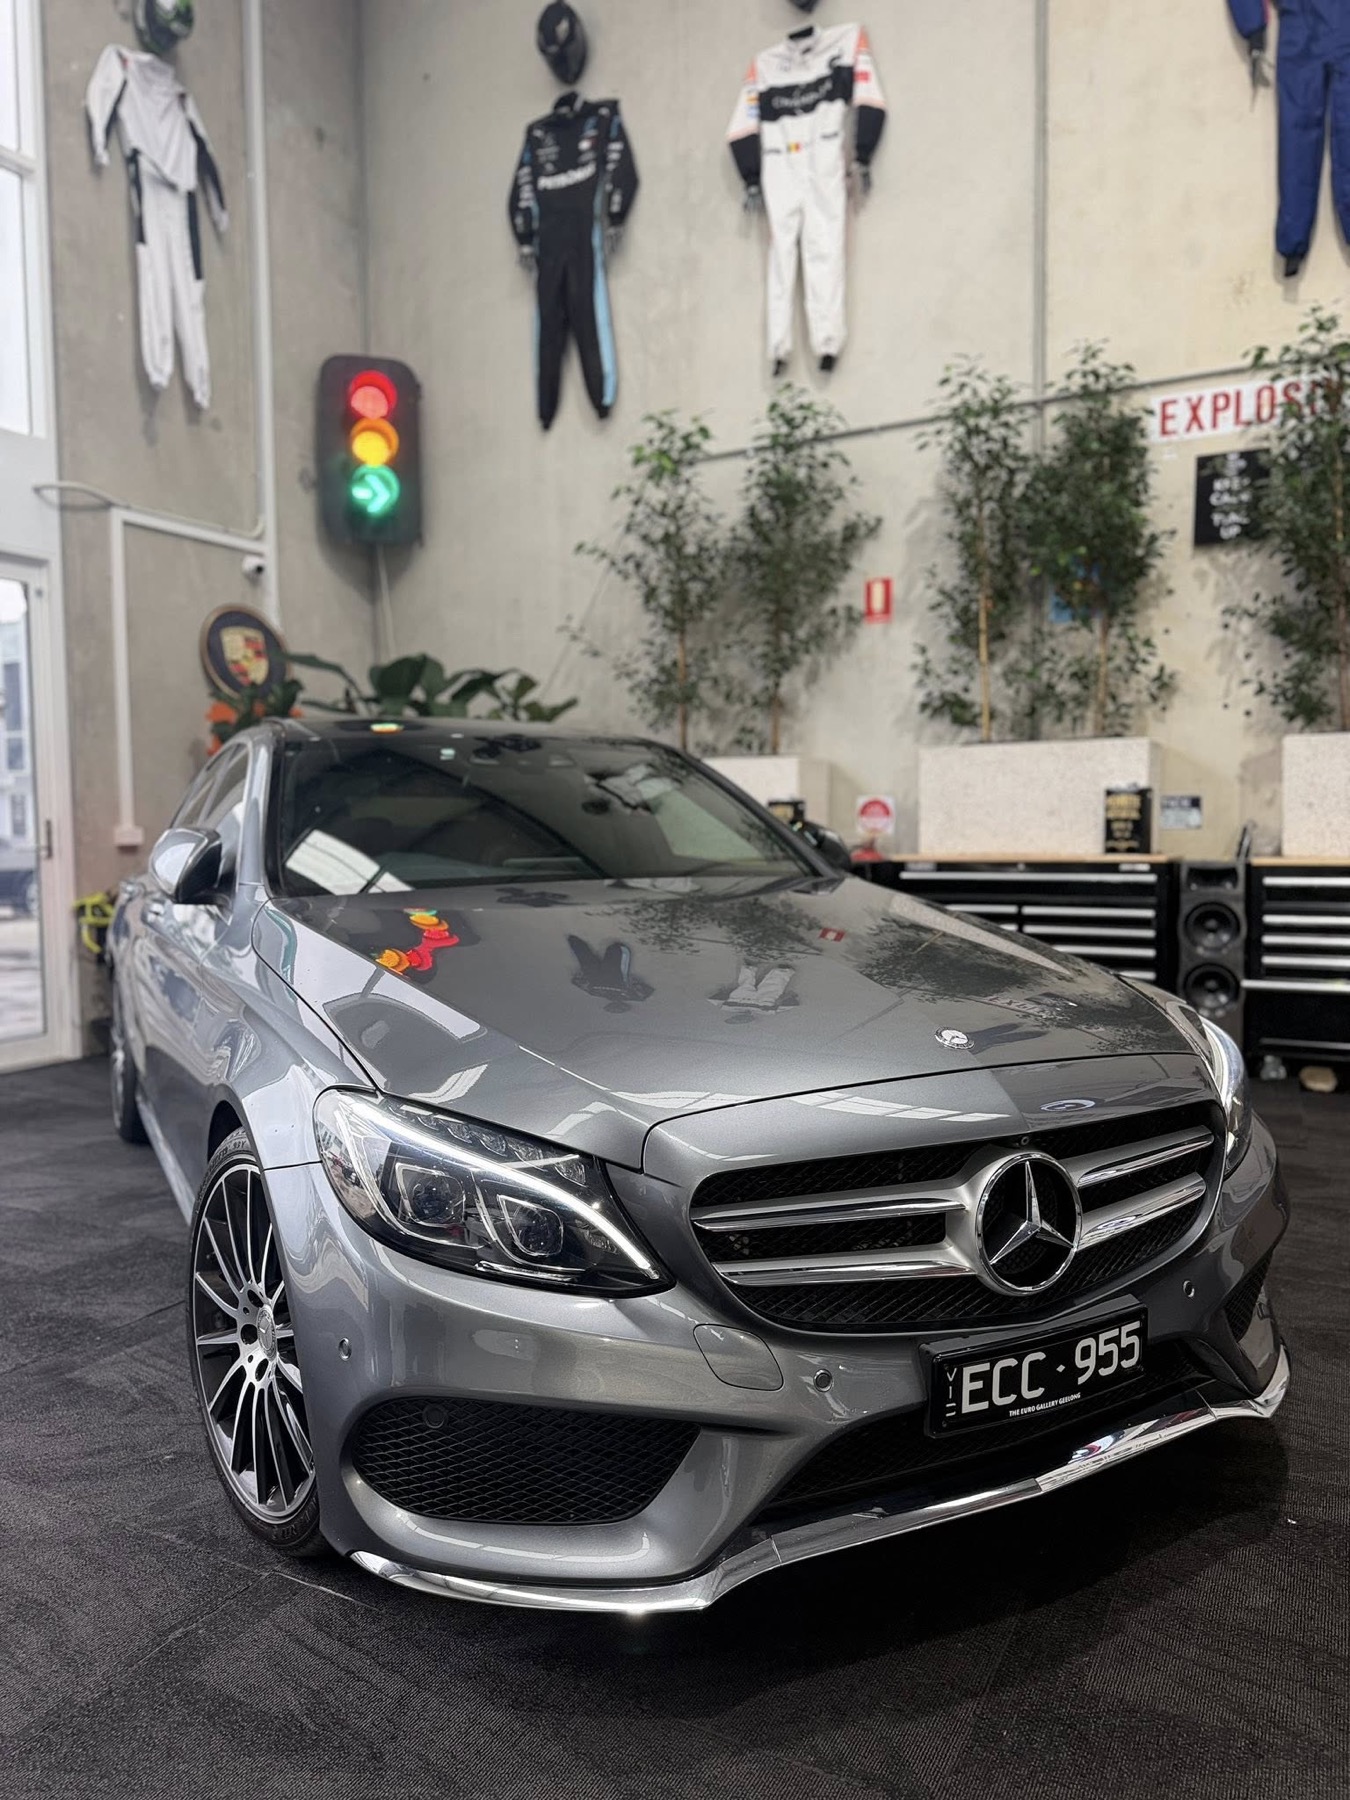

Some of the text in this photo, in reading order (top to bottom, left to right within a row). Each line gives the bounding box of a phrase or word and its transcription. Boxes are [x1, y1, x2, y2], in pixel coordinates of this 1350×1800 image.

[961, 1320, 1141, 1414] ECC 955
[1009, 1392, 1081, 1417] THE EURO GALLERY GEELONG
